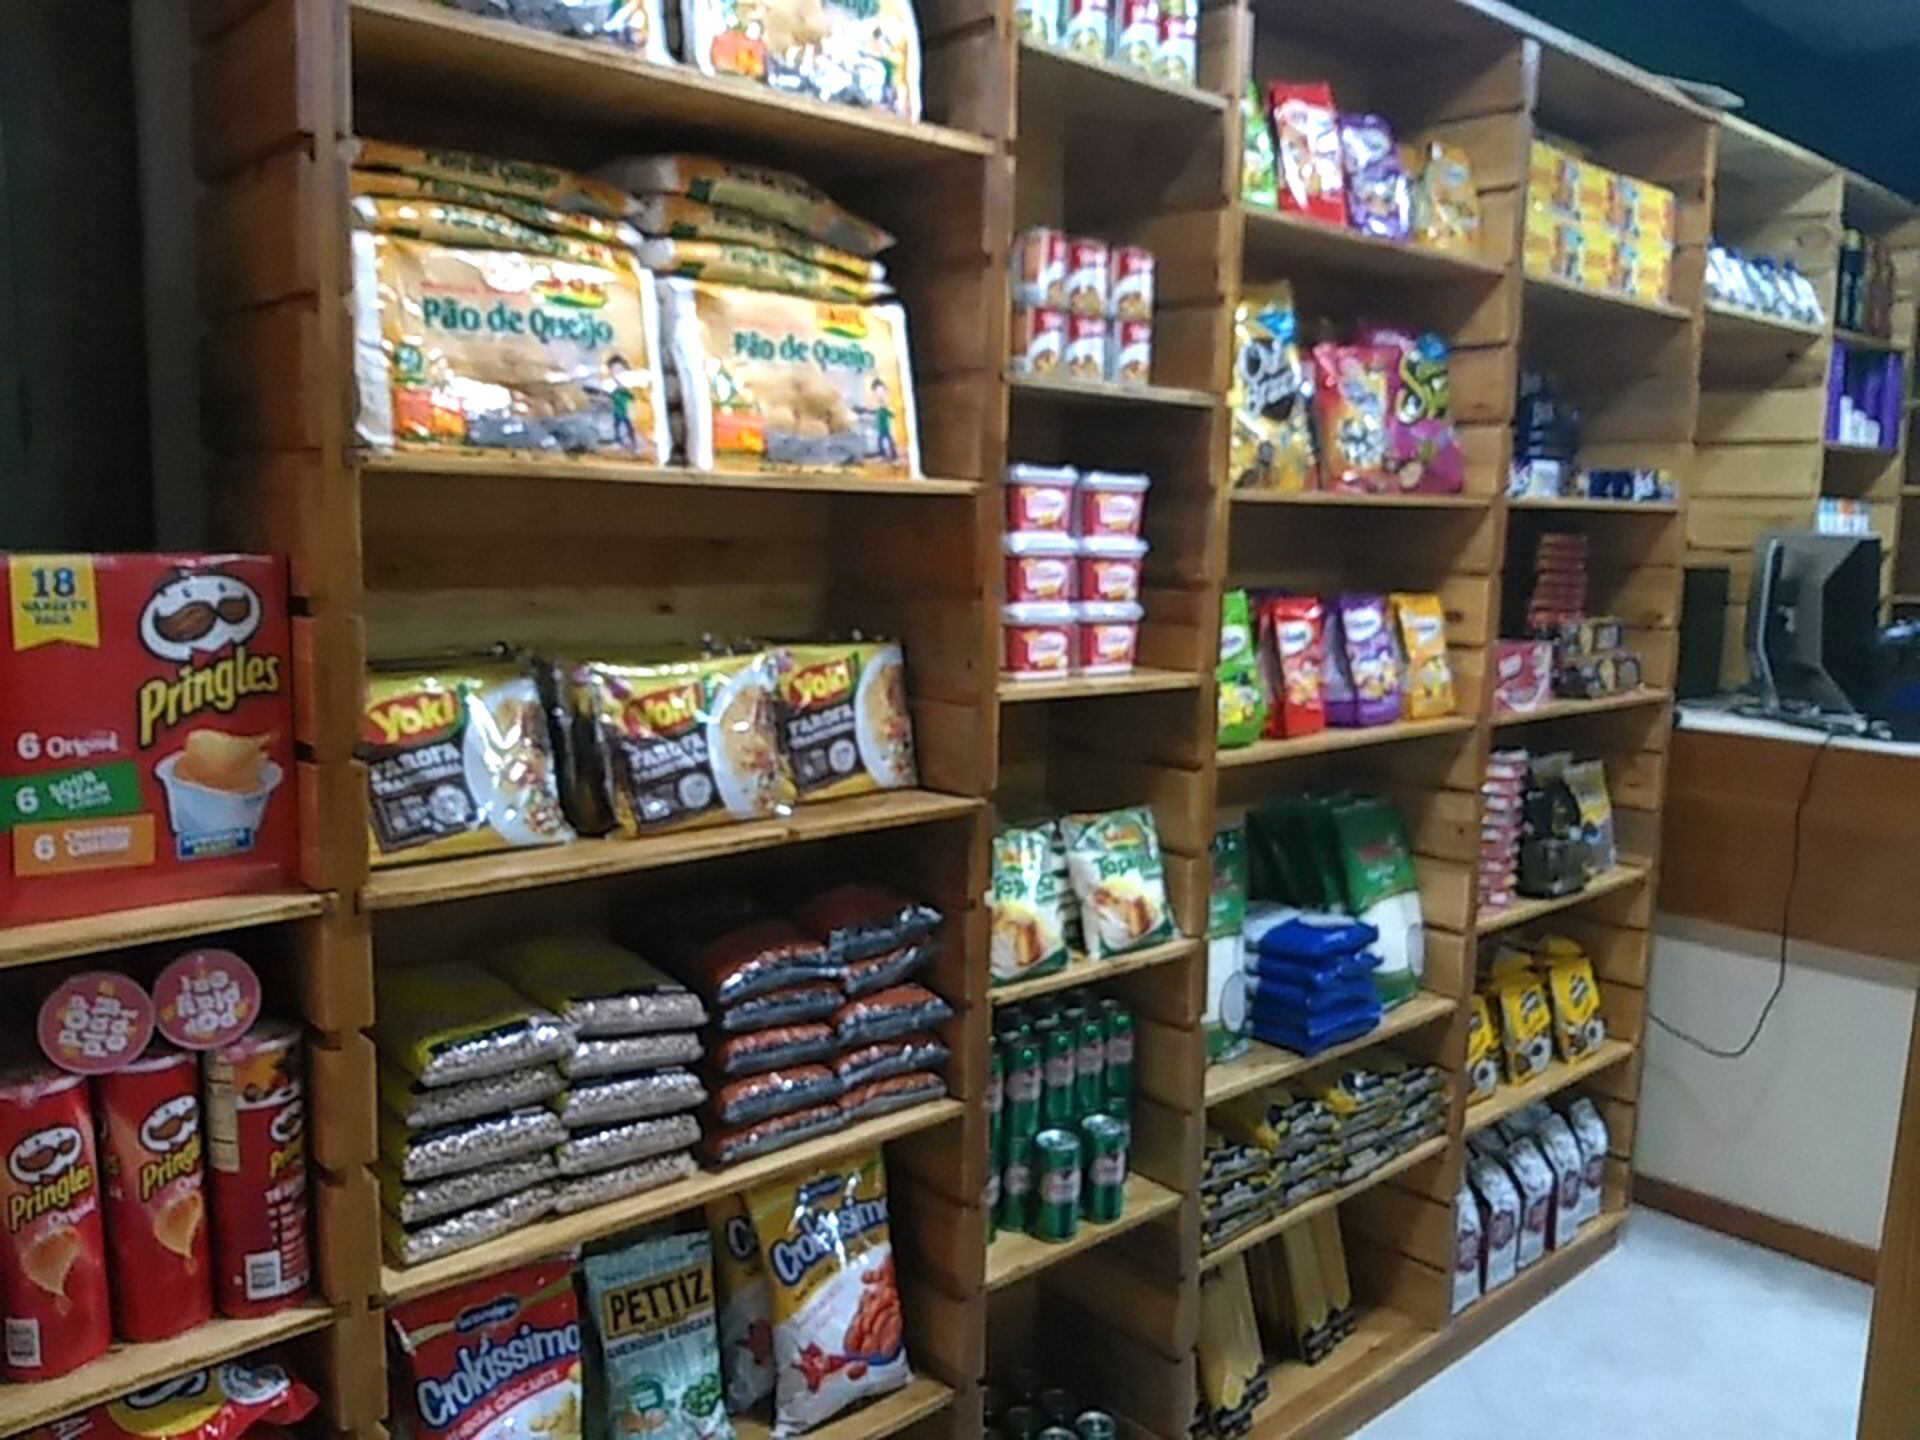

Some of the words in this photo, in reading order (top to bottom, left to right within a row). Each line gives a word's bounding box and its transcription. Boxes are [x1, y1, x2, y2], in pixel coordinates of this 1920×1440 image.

[423, 296, 481, 331] Pão
[487, 302, 525, 335] de
[529, 308, 613, 350] Queijo
[780, 333, 809, 362] de
[813, 339, 876, 374] Queijo
[32, 566, 75, 597] 18
[139, 646, 280, 747] Pringles
[17, 732, 41, 760] 6
[16, 786, 40, 814] 6
[33, 834, 56, 860] 6
[10, 1165, 92, 1232] Pringles
[610, 1269, 709, 1331] PETTIZ
